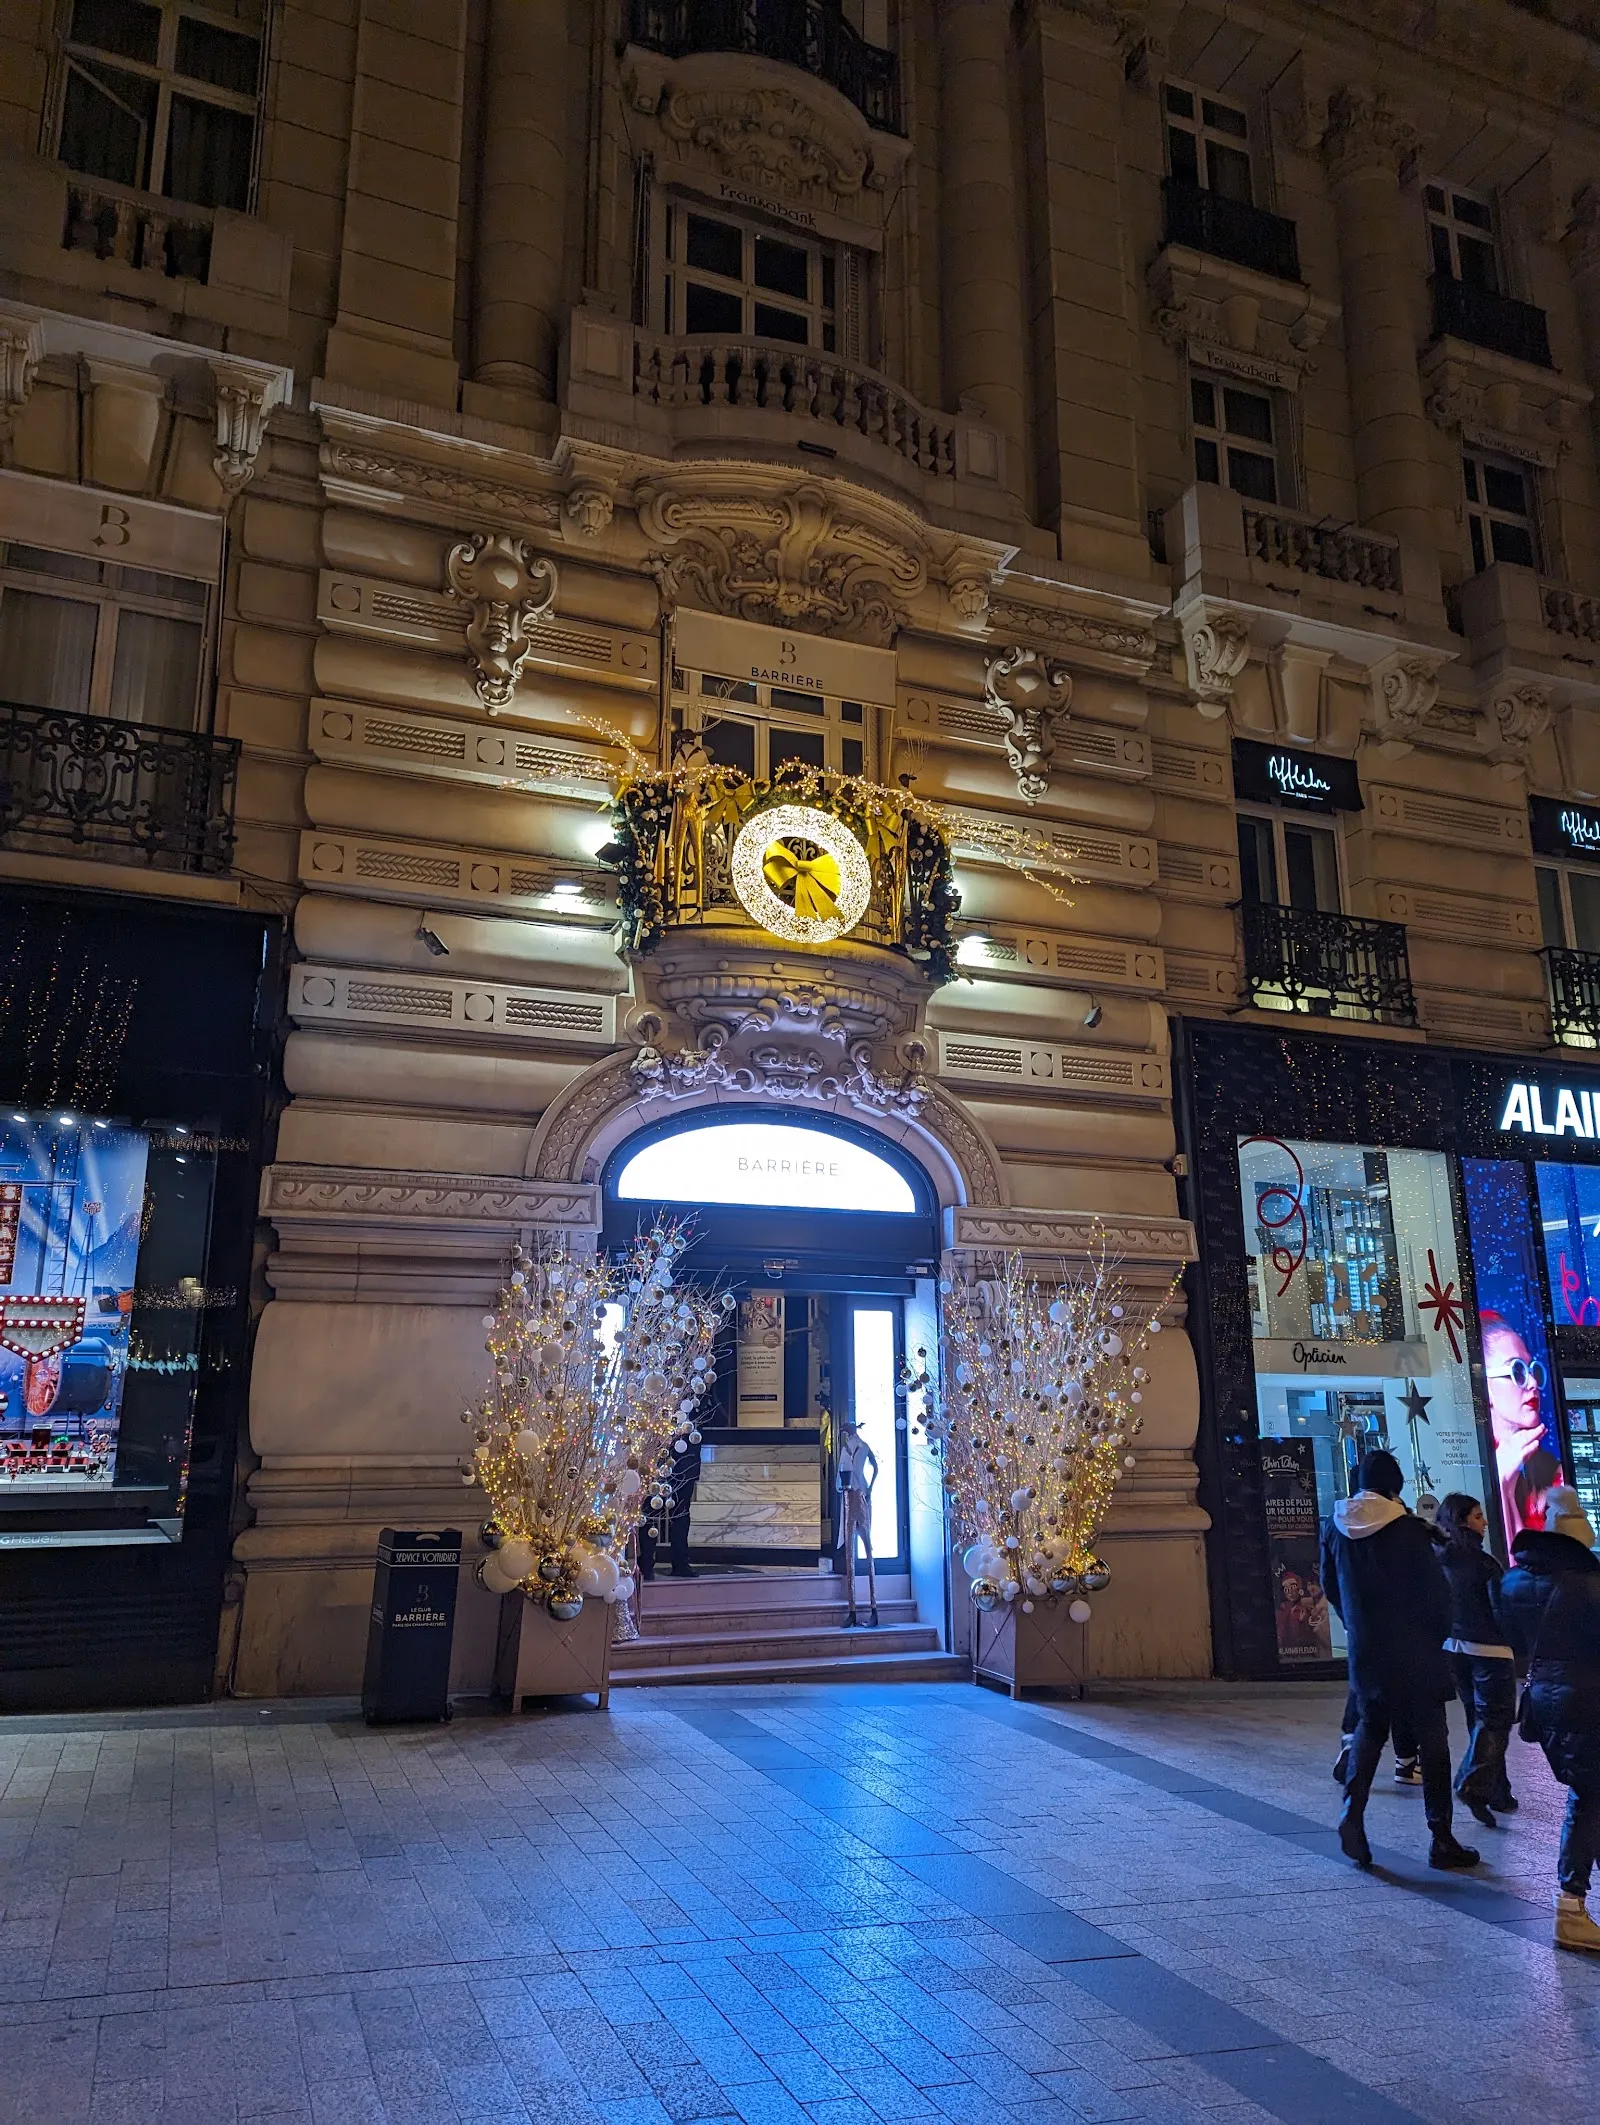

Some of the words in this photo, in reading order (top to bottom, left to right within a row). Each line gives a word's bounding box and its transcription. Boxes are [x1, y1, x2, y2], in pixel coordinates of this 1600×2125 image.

[751, 666, 824, 690] BARRIÈRE
[738, 1156, 839, 1177] BARRIÈRE
[1293, 1342, 1347, 1372] Opticien
[1285, 1498, 1295, 1507] DE
[1295, 1498, 1313, 1507] PLUS
[1286, 1507, 1295, 1515] DE
[396, 1552, 421, 1563] SERVICE
[422, 1552, 458, 1563] VOITURIER
[395, 1613, 446, 1622] BARRIÈRE
